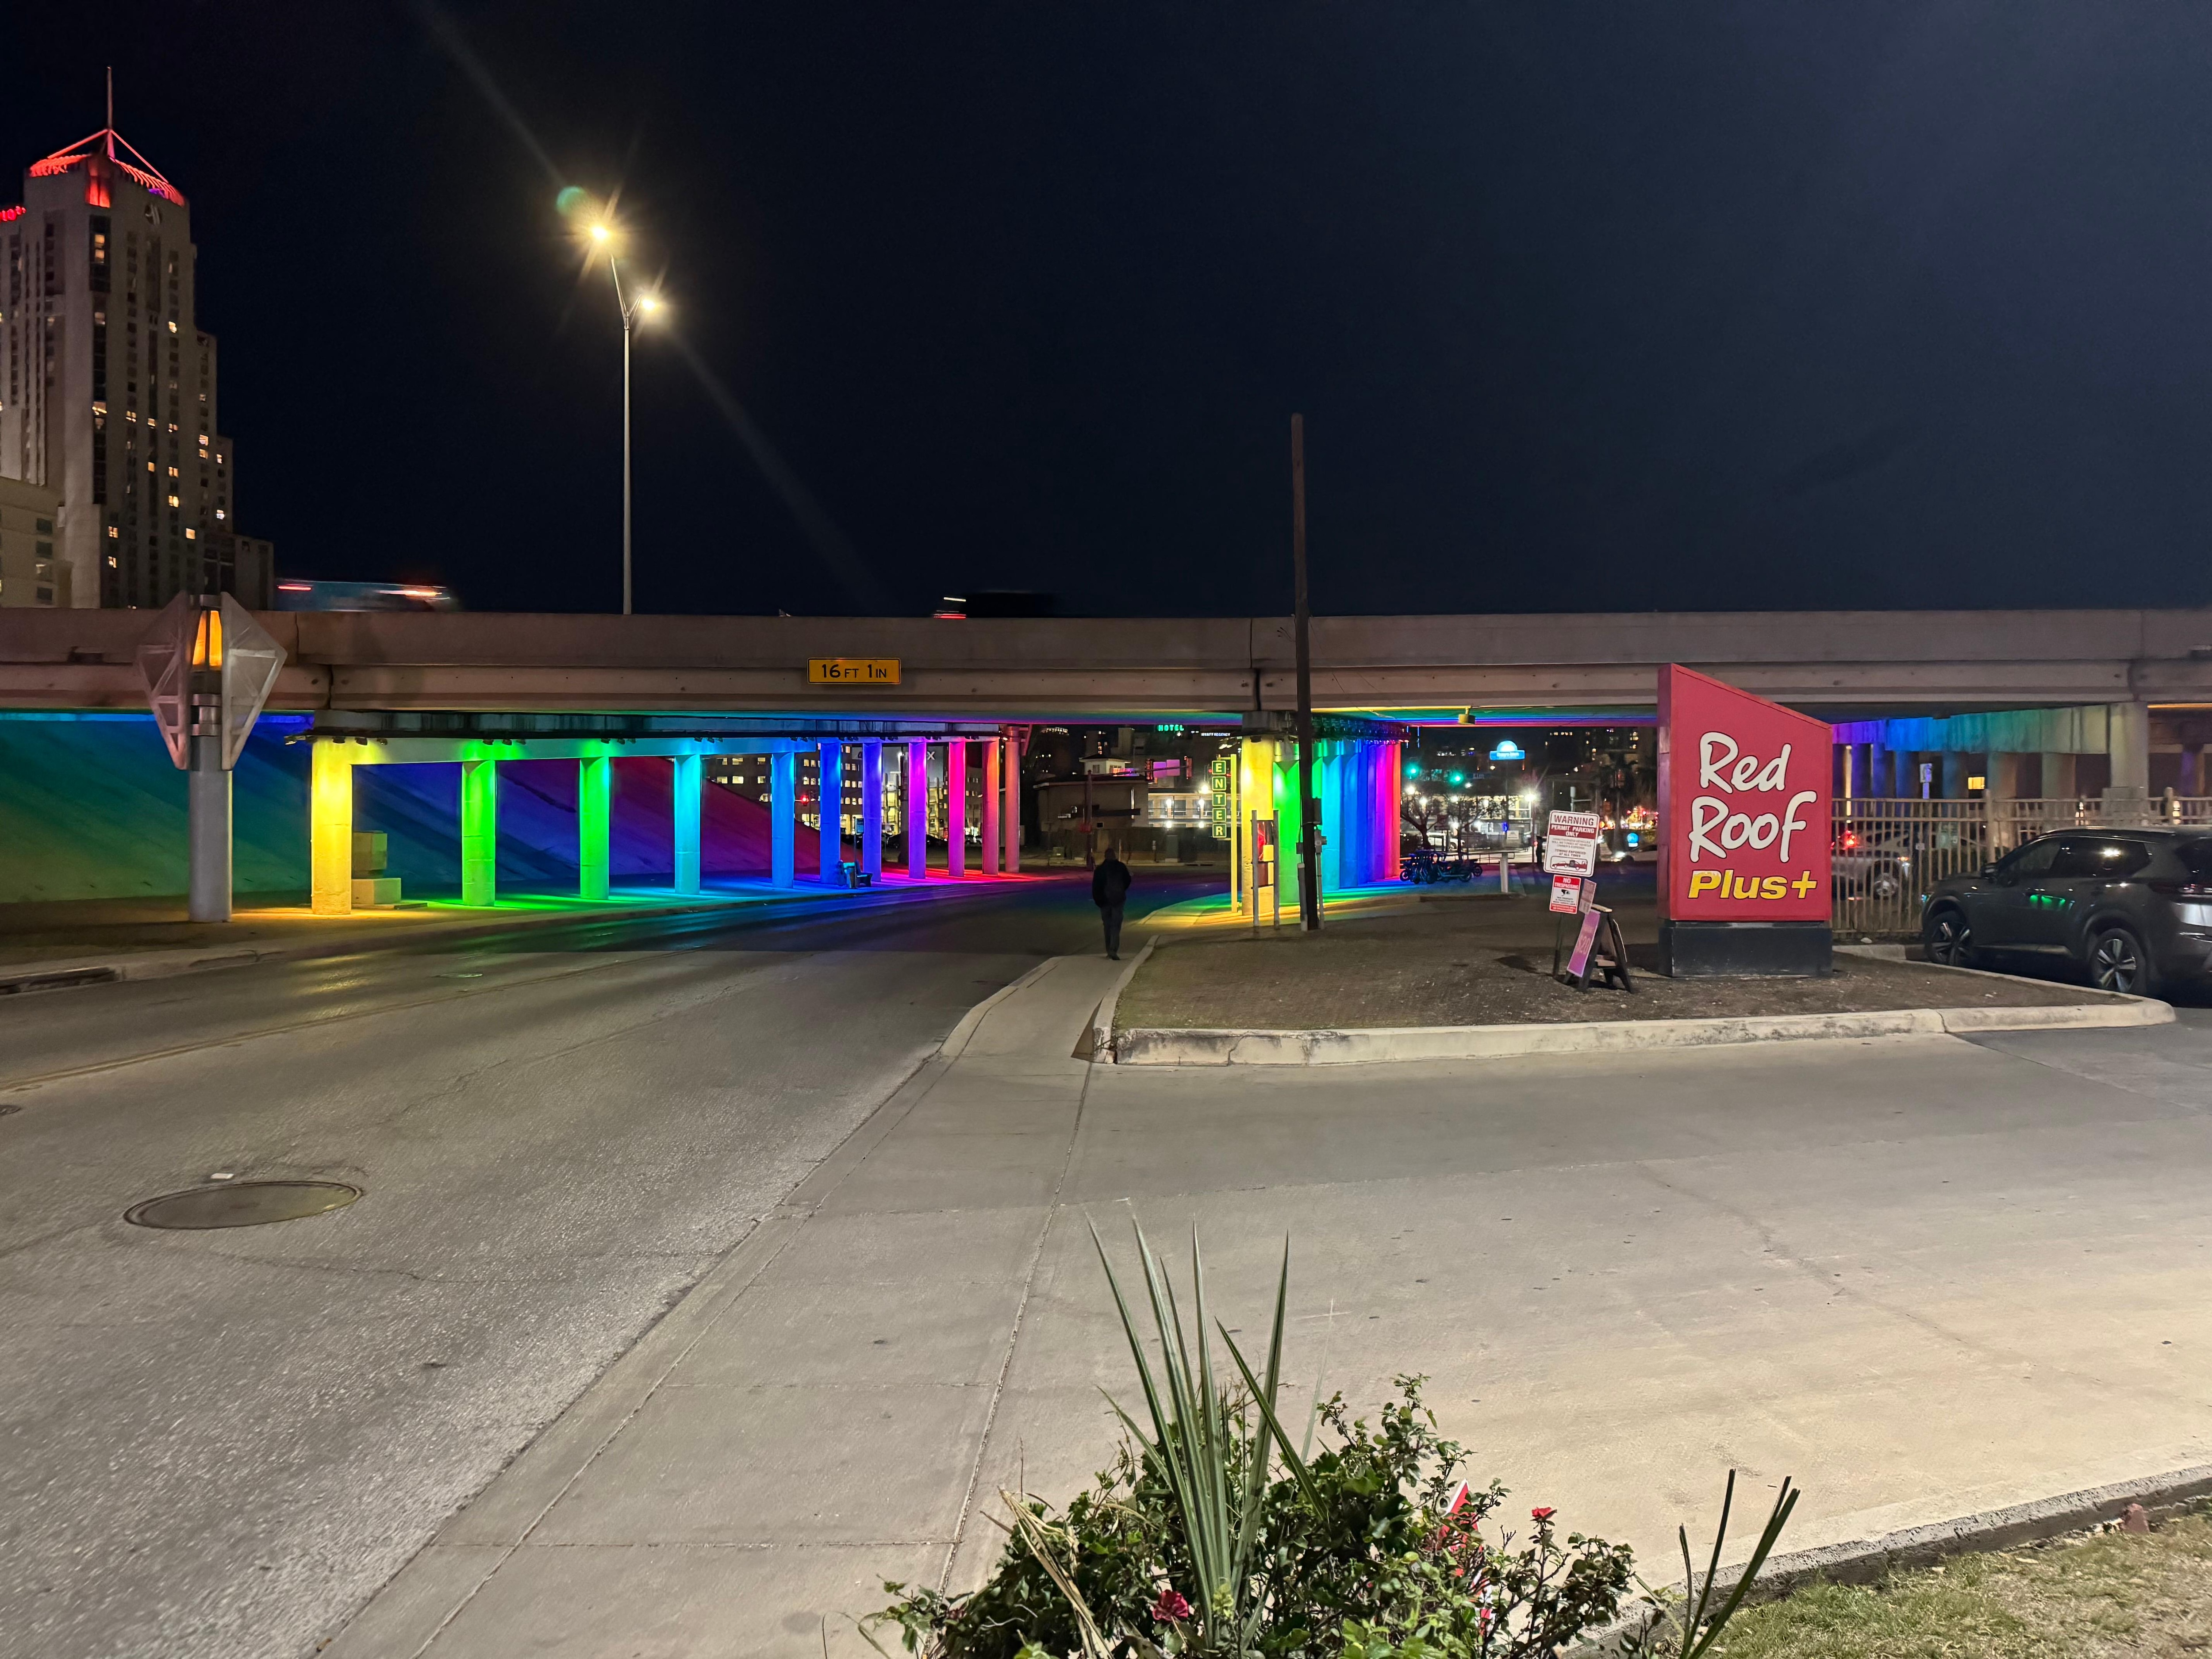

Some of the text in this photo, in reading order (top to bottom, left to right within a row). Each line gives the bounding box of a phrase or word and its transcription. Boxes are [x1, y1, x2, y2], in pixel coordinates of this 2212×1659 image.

[822, 664, 887, 678] 16 FT 1 IN
[1700, 731, 1791, 795] Red
[1554, 814, 1594, 826] WARNING
[1689, 791, 1817, 863] Roof
[1688, 869, 1818, 900] Plus+
